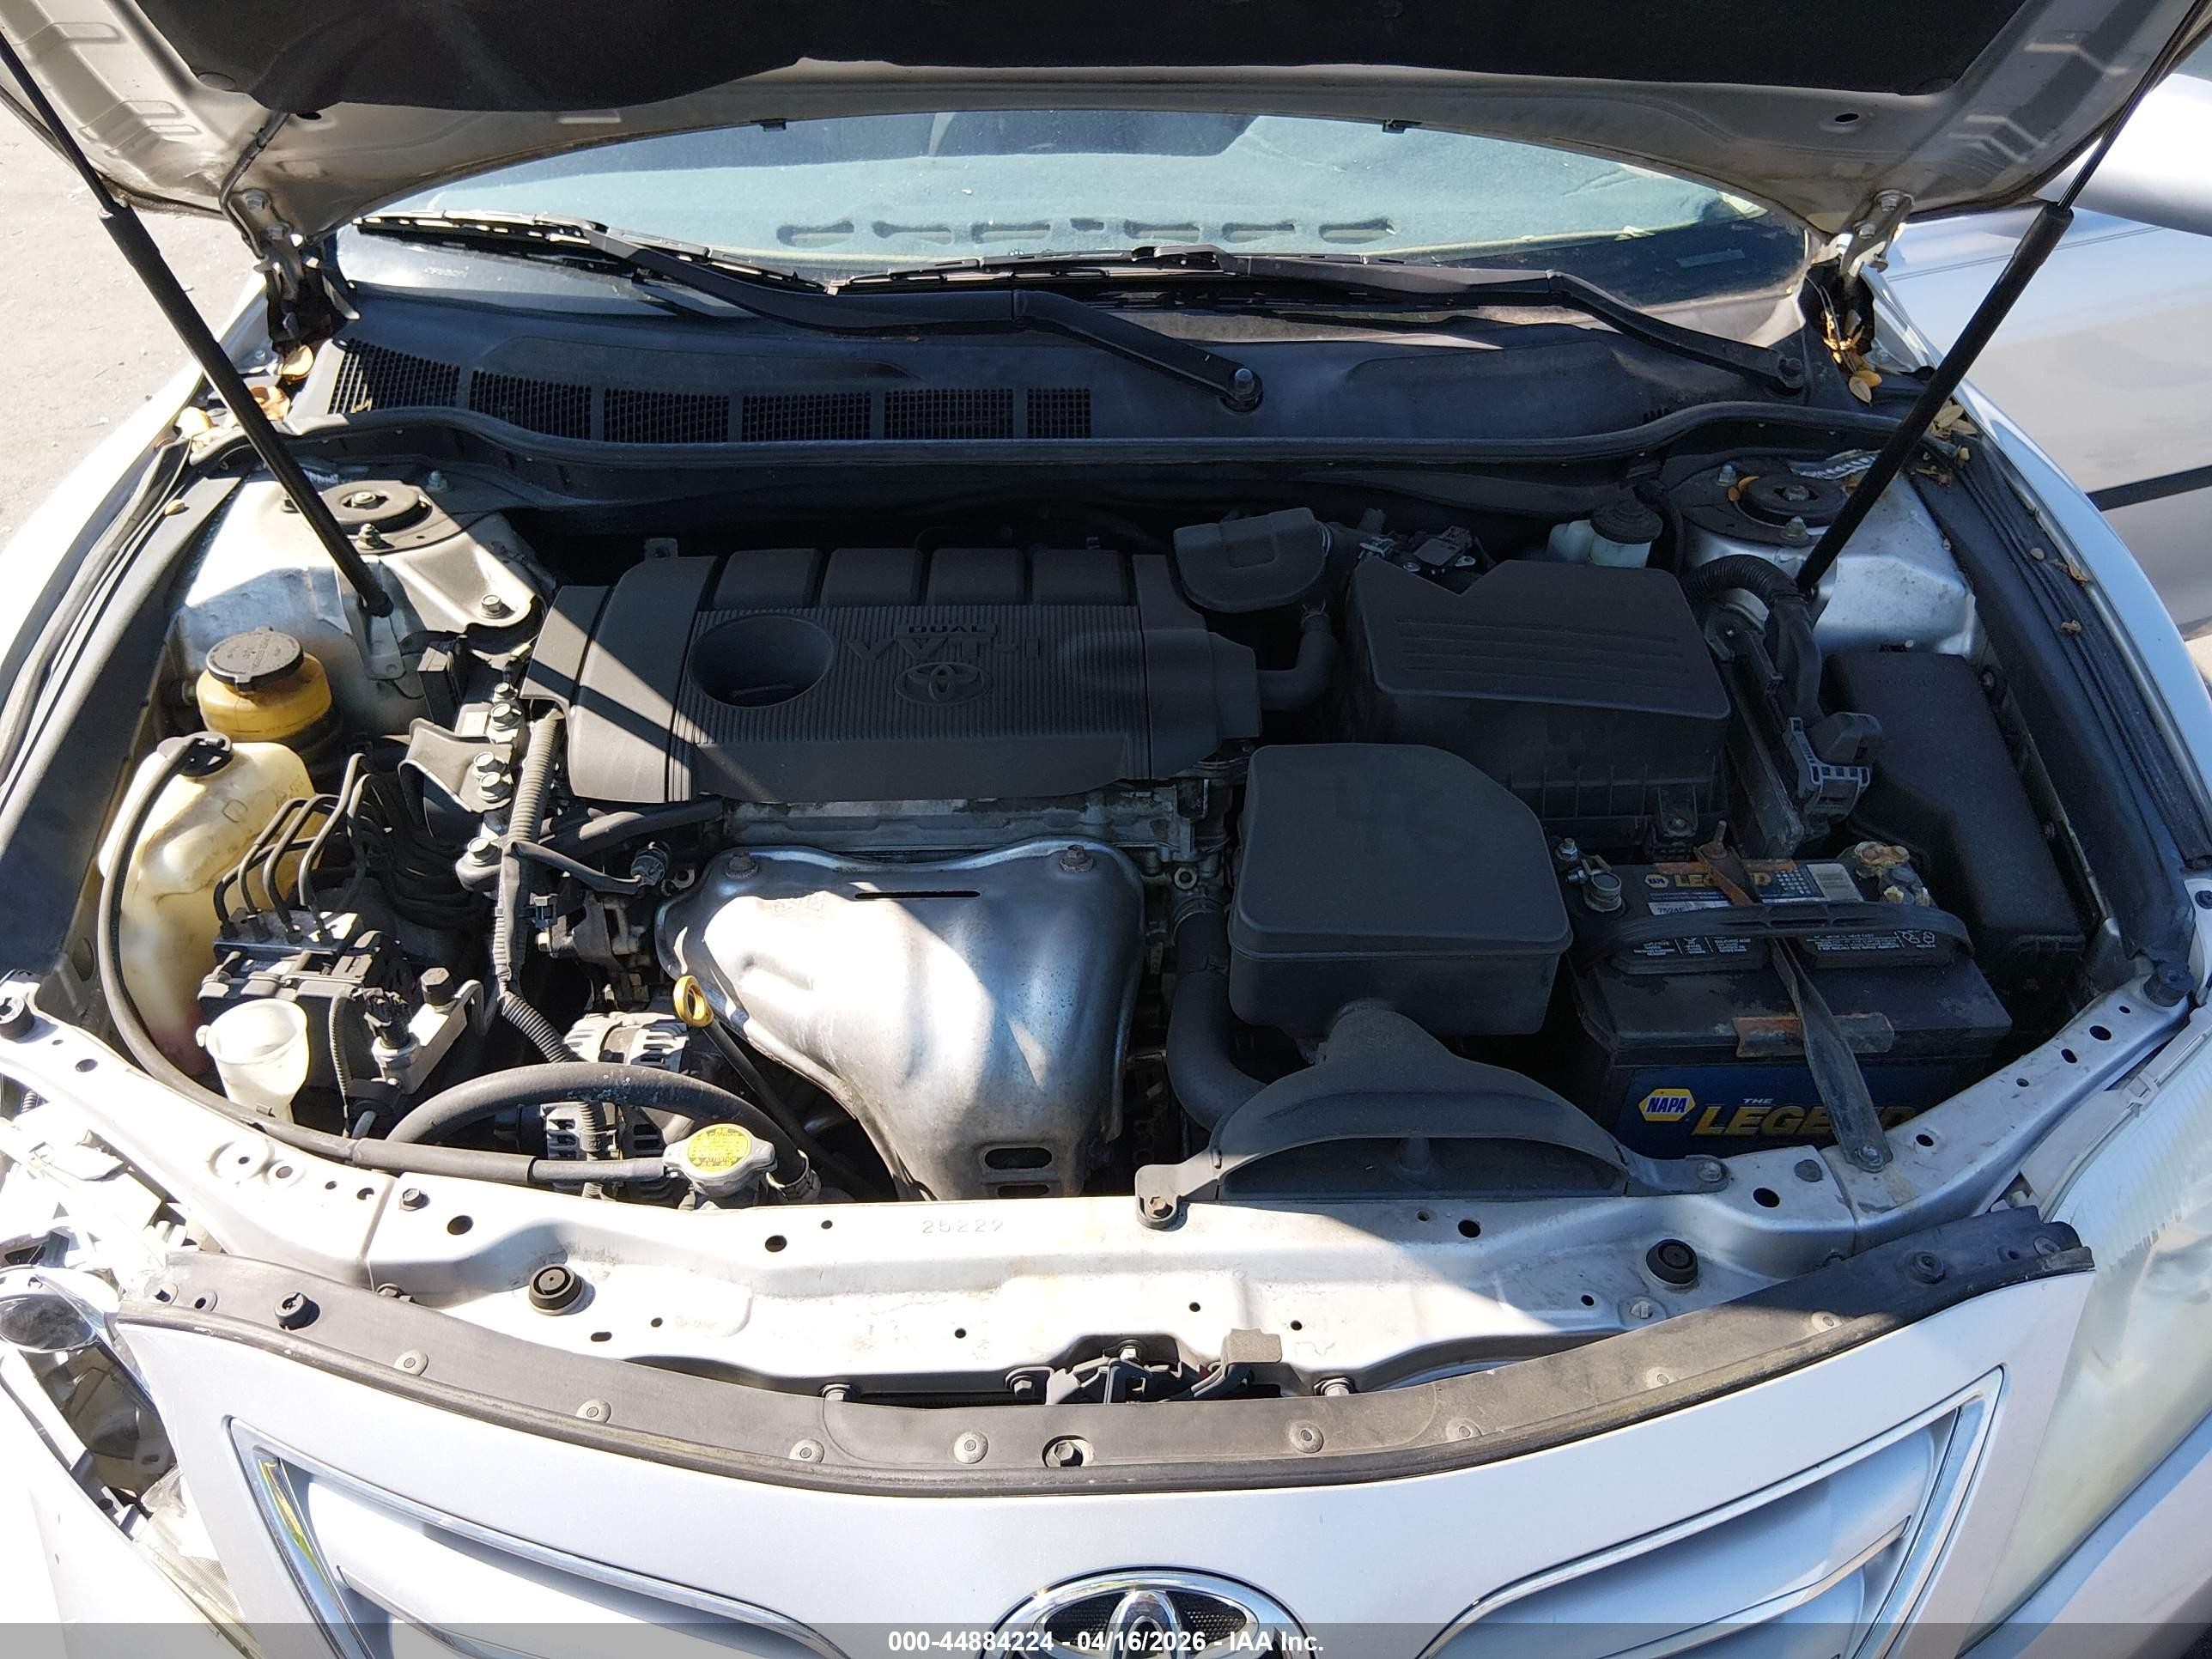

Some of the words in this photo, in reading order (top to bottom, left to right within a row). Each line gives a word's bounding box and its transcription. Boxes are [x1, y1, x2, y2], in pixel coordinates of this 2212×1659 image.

[908, 624, 988, 634] DUAL
[1646, 1097, 1687, 1114] NAPA
[1691, 1105, 1917, 1137] LEGED
